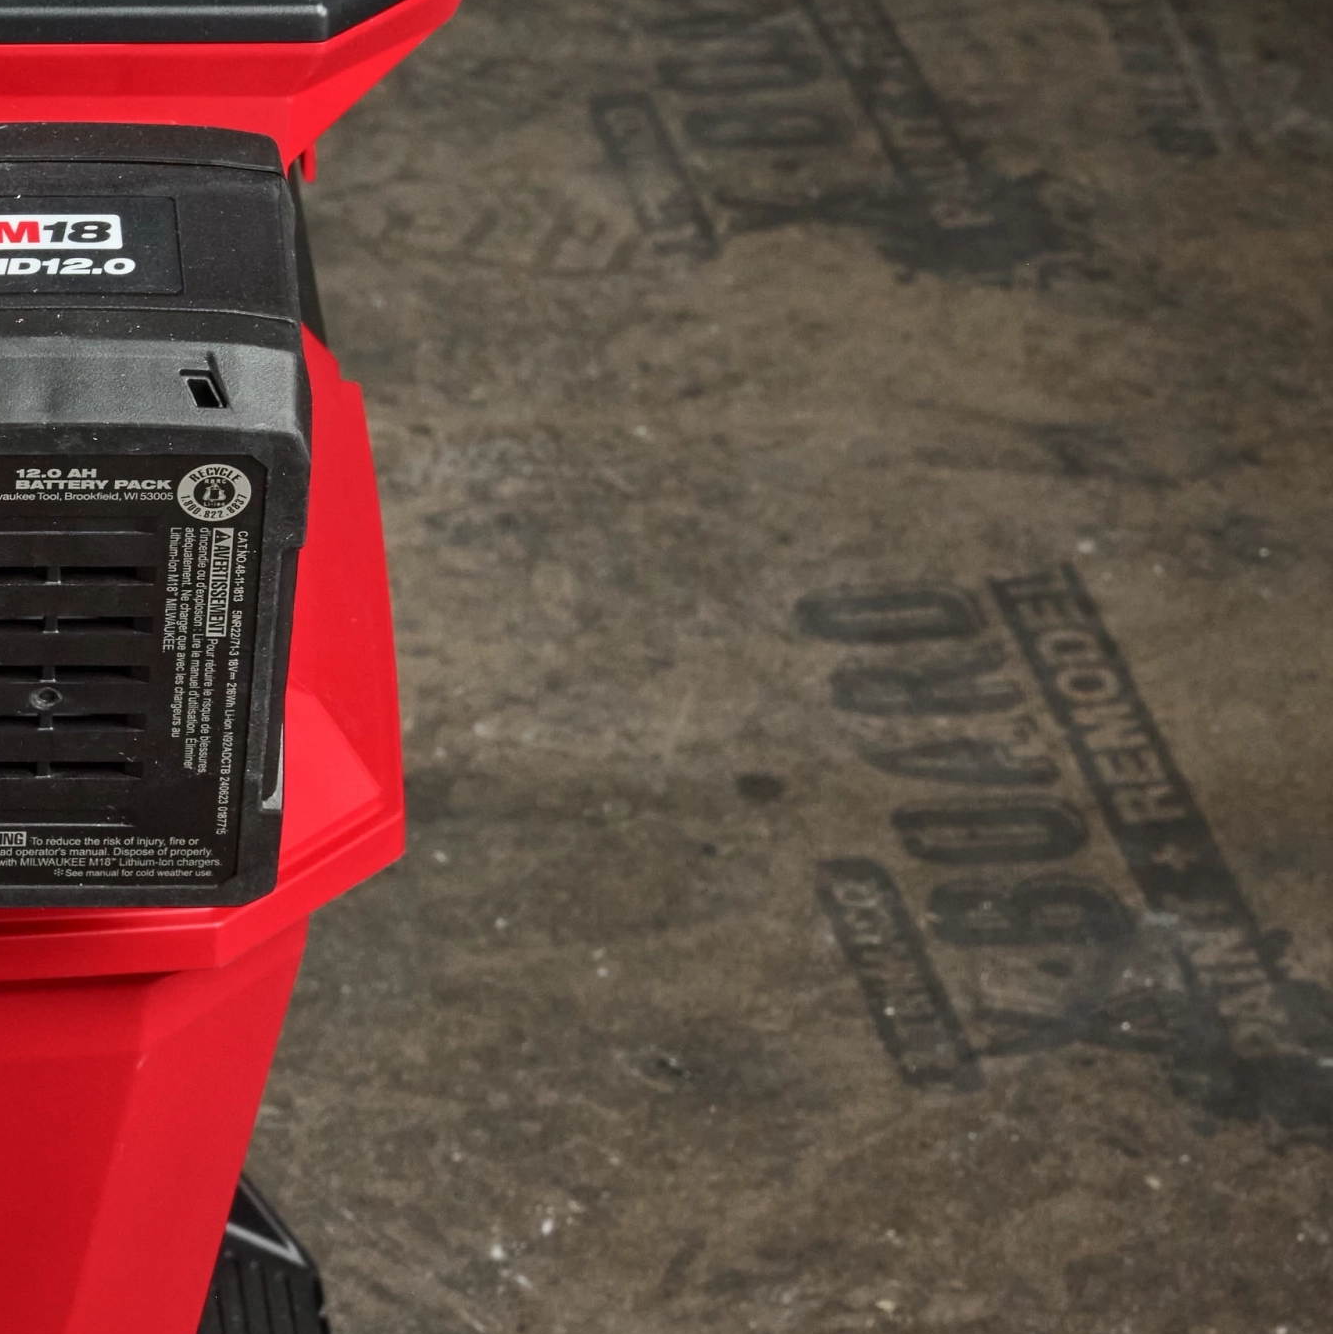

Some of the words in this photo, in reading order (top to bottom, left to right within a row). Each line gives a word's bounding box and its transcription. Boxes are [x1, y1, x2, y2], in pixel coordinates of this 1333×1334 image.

[16, 468, 62, 479] 12.0
[71, 468, 98, 479] AH
[189, 467, 242, 482] RECYCLE
[15, 479, 111, 490] BATTERY
[115, 479, 172, 490] PACK
[37, 492, 63, 502] Tool,
[64, 492, 121, 502] Brookfield,
[124, 492, 138, 501] WI
[140, 492, 174, 501] 53005
[196, 570, 206, 580] ou
[180, 590, 192, 601] Ne
[208, 545, 230, 634] AVERTISSEMENT
[177, 603, 190, 633] charger
[177, 635, 187, 650] que
[192, 634, 204, 648] Lire
[206, 639, 218, 657] Pour
[176, 652, 185, 671] avec
[175, 673, 186, 685] les
[189, 660, 200, 688] manuel
[1005, 564, 1187, 825] REMODEL
[171, 687, 185, 725] chargeurs
[199, 698, 214, 722] risque
[171, 727, 180, 738] au
[200, 724, 212, 734] de
[31, 837, 43, 846] To
[46, 836, 81, 846] reduce
[84, 837, 100, 846] the
[103, 837, 121, 846] risk
[124, 837, 135, 846] of
[137, 837, 166, 847] injury,
[169, 837, 185, 846] fire
[15, 848, 66, 858] operator's
[69, 848, 109, 856] manual.
[113, 847, 155, 857] Dispose
[157, 847, 168, 856] of
[170, 848, 213, 857] properly.
[20, 858, 86, 866] MILWAUKEE
[177, 858, 222, 868] chargers.
[65, 869, 83, 877] See
[86, 869, 119, 877] manual
[121, 869, 133, 877] for
[136, 869, 155, 877] cold
[157, 869, 193, 877] weather
